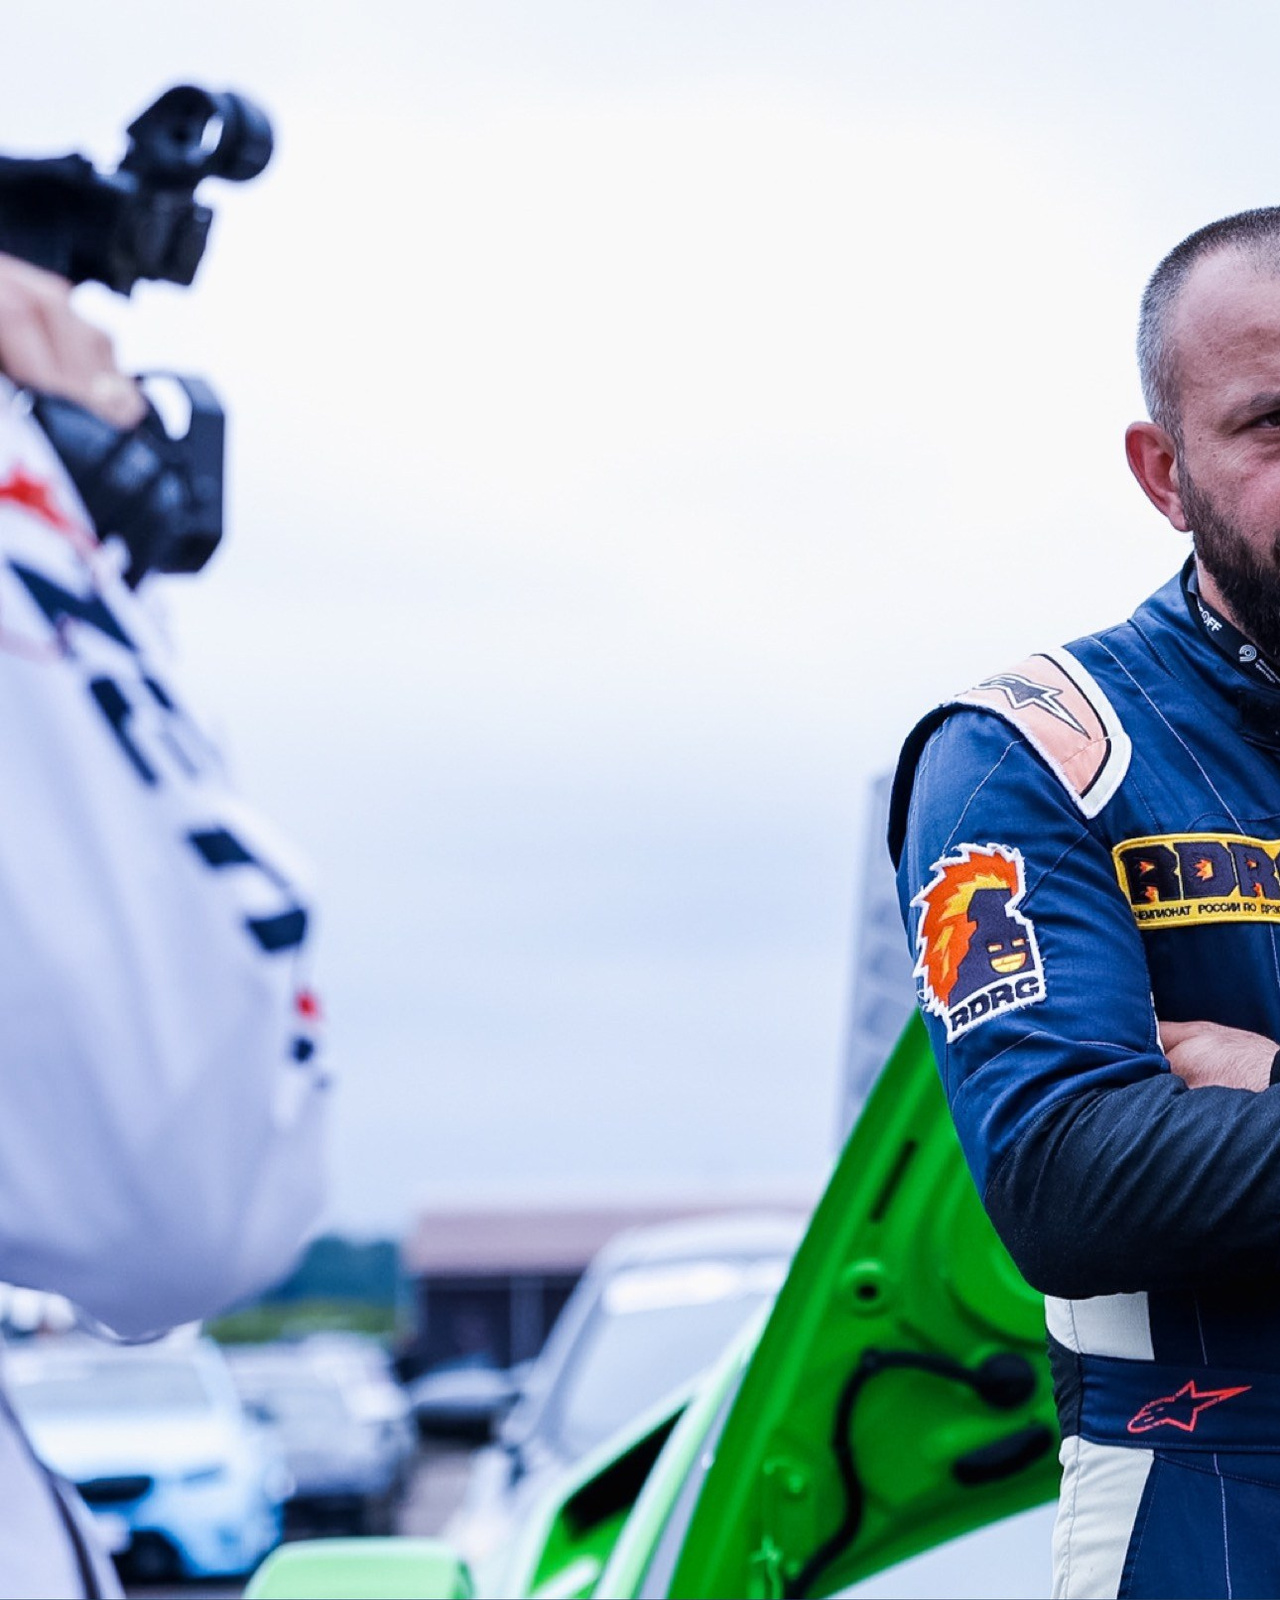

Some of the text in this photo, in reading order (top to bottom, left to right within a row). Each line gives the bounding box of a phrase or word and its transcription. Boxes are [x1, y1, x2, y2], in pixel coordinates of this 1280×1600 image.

[1198, 903, 1241, 914] РОССИИ
[1243, 902, 1257, 912] ПО
[949, 976, 1040, 1032] RDRC
